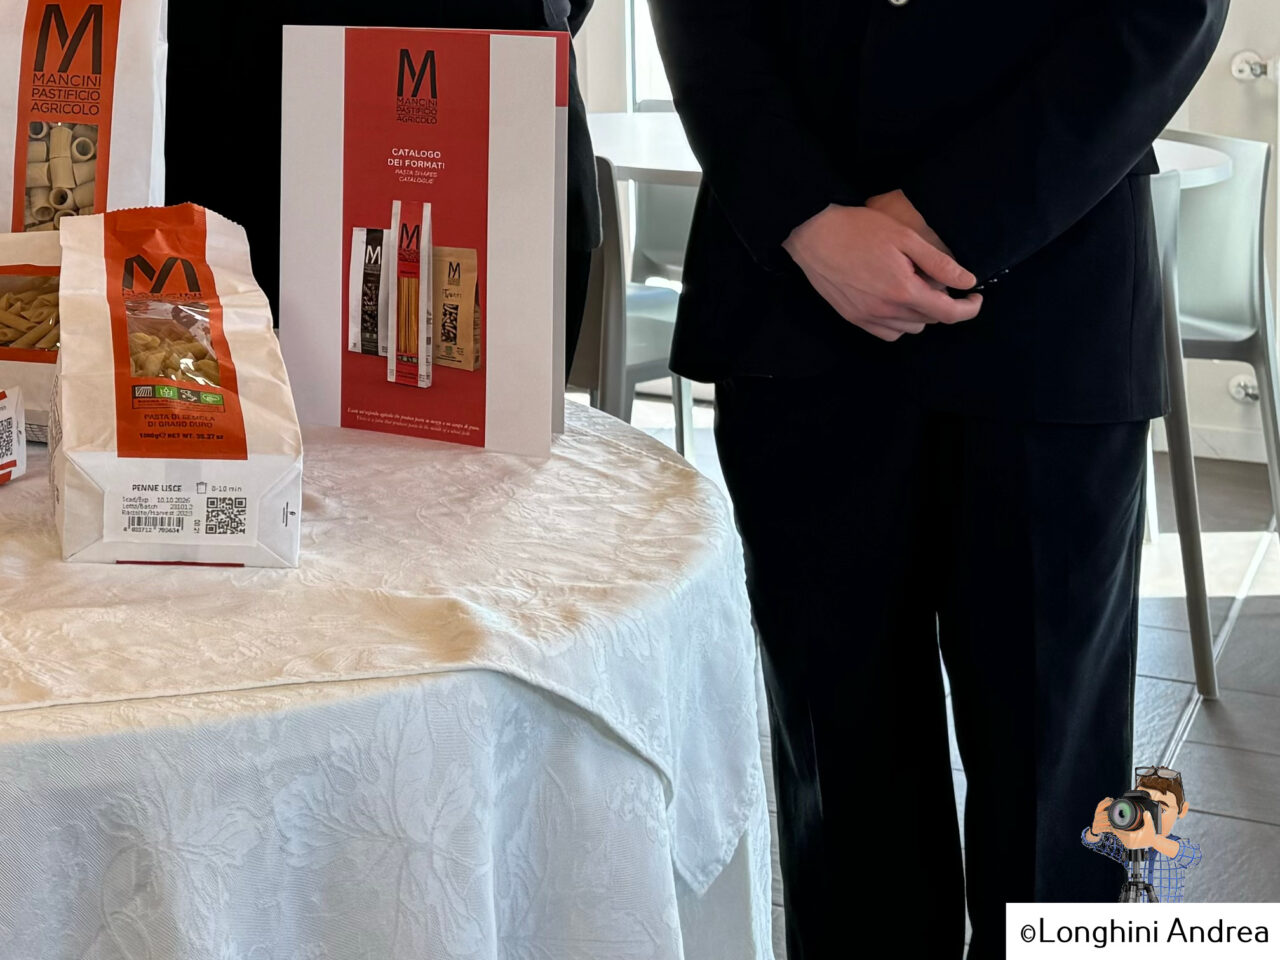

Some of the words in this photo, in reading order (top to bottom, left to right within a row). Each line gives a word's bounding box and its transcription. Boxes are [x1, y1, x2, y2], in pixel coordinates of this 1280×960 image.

[33, 4, 103, 75] M
[32, 74, 101, 87] MANCINI
[397, 49, 438, 99] M
[31, 88, 100, 101] PASTIFICIO
[30, 102, 100, 115] AGRICOLO
[397, 97, 438, 107] MANCINI
[396, 114, 438, 125] AGRICOLO
[391, 148, 441, 159] CATALOGO
[387, 158, 403, 167] DEI
[404, 159, 445, 169] FORMATI
[123, 254, 201, 293] M
[132, 484, 160, 492] PENNE
[161, 484, 182, 493] LISCE
